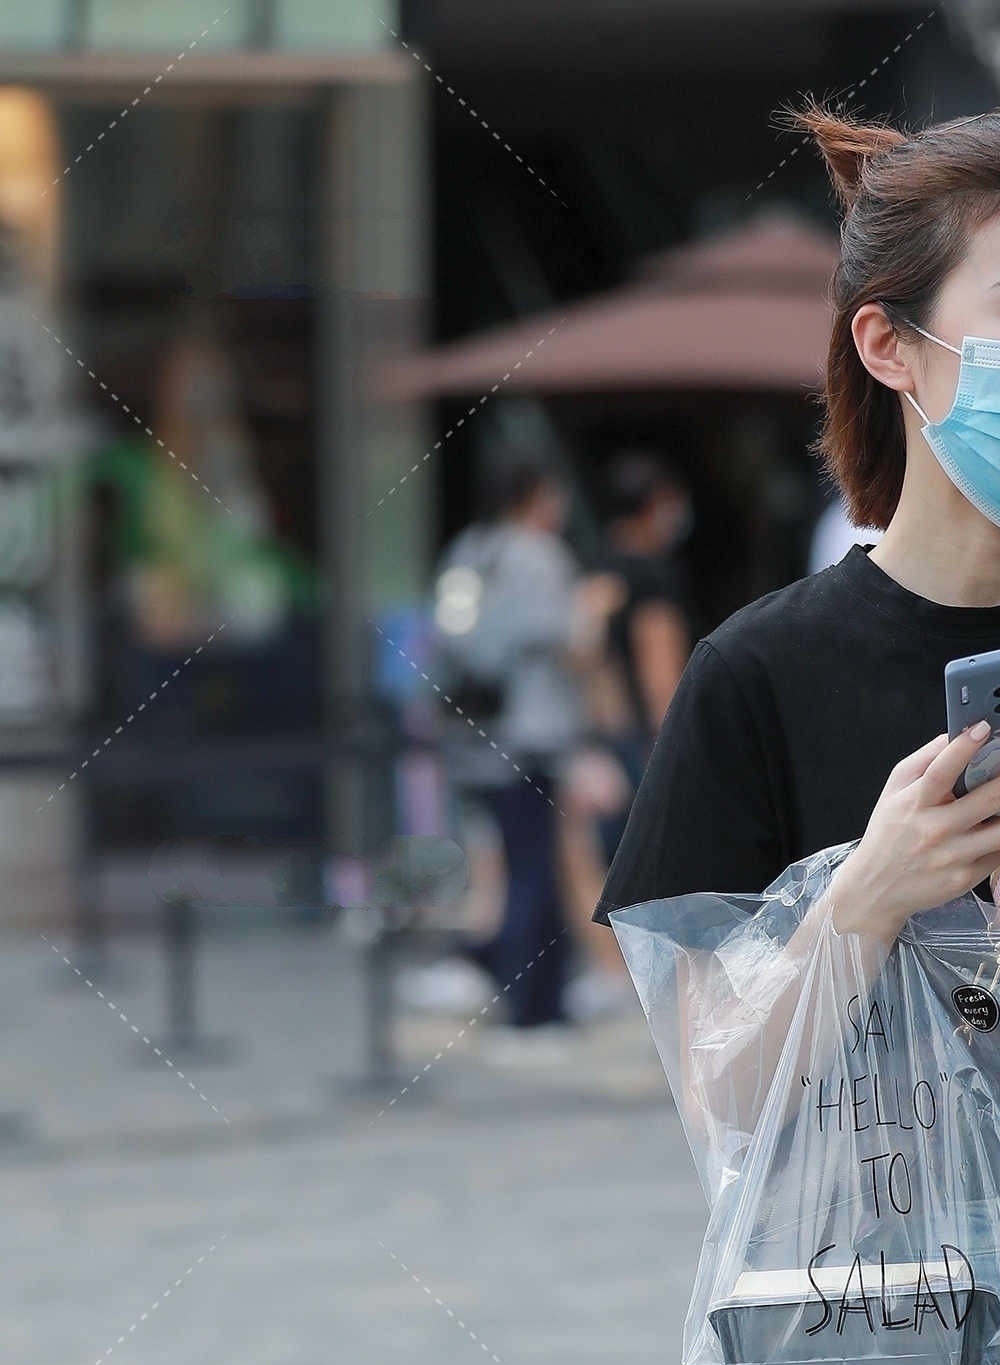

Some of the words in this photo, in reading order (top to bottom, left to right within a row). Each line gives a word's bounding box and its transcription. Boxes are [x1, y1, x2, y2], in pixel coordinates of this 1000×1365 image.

[957, 992, 986, 1003] Fresh
[963, 1006, 989, 1016] every
[846, 993, 895, 1054] SAY
[971, 1016, 988, 1028] day
[860, 1152, 912, 1219] TO
[805, 1243, 976, 1337] SALAD
